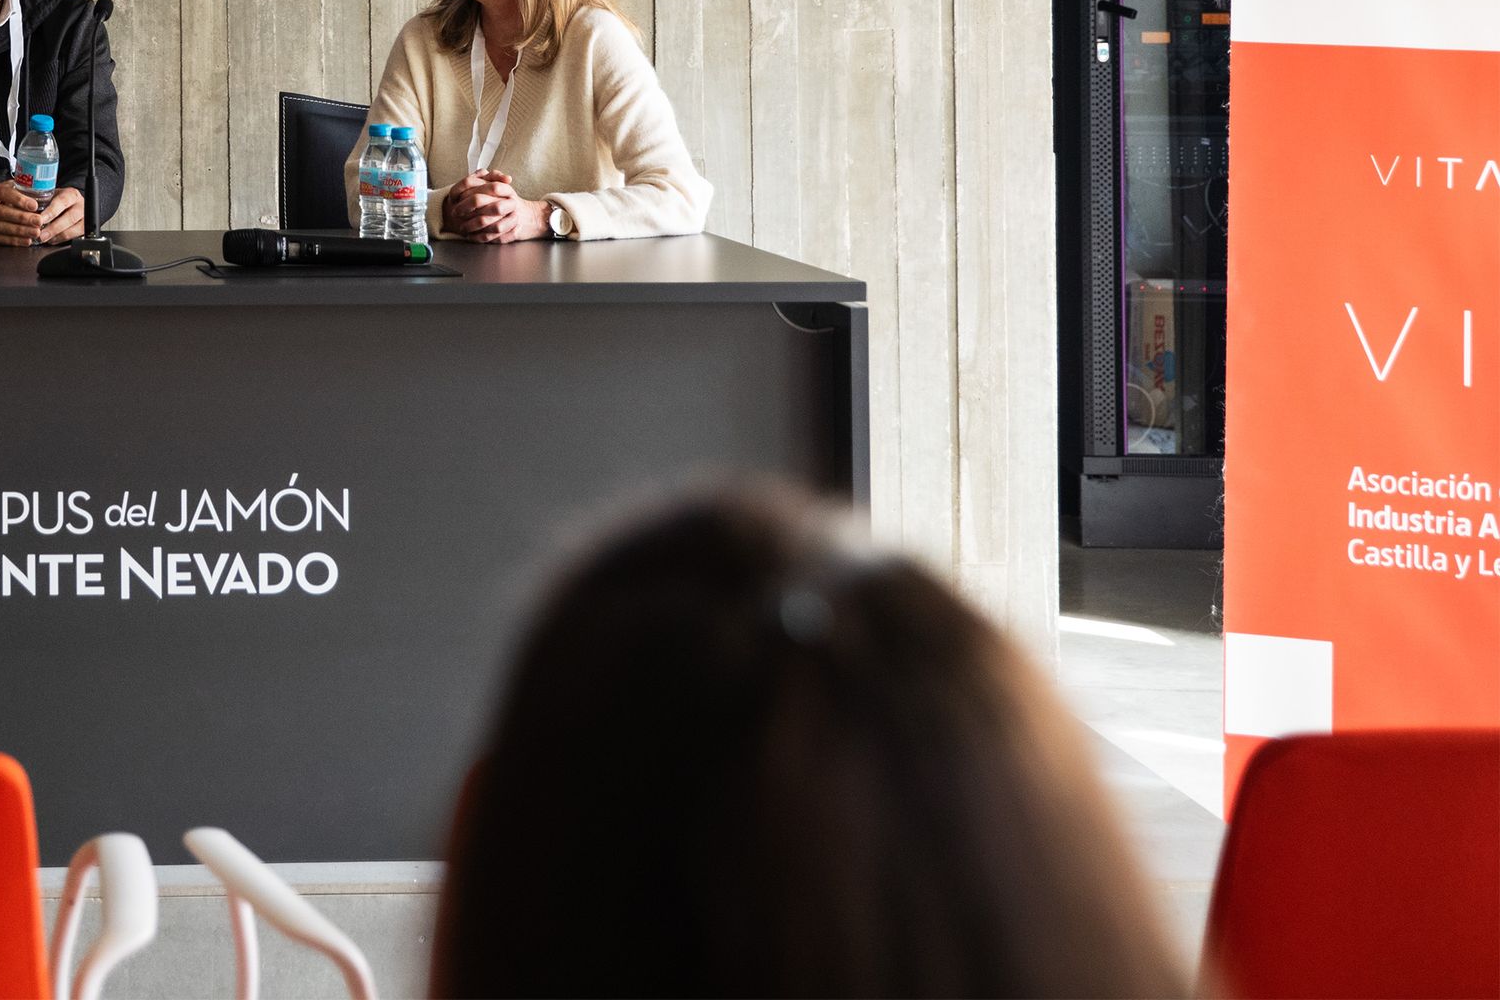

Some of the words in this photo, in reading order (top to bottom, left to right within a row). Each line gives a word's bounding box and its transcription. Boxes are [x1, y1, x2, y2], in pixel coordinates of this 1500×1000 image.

[105, 491, 157, 526] del
[165, 473, 349, 532] JAMÓN
[1348, 466, 1492, 502] Asociación
[1348, 502, 1472, 537] Industria
[121, 547, 338, 599] NEVADO
[1348, 538, 1448, 572] Castilla
[1454, 554, 1471, 579] y
